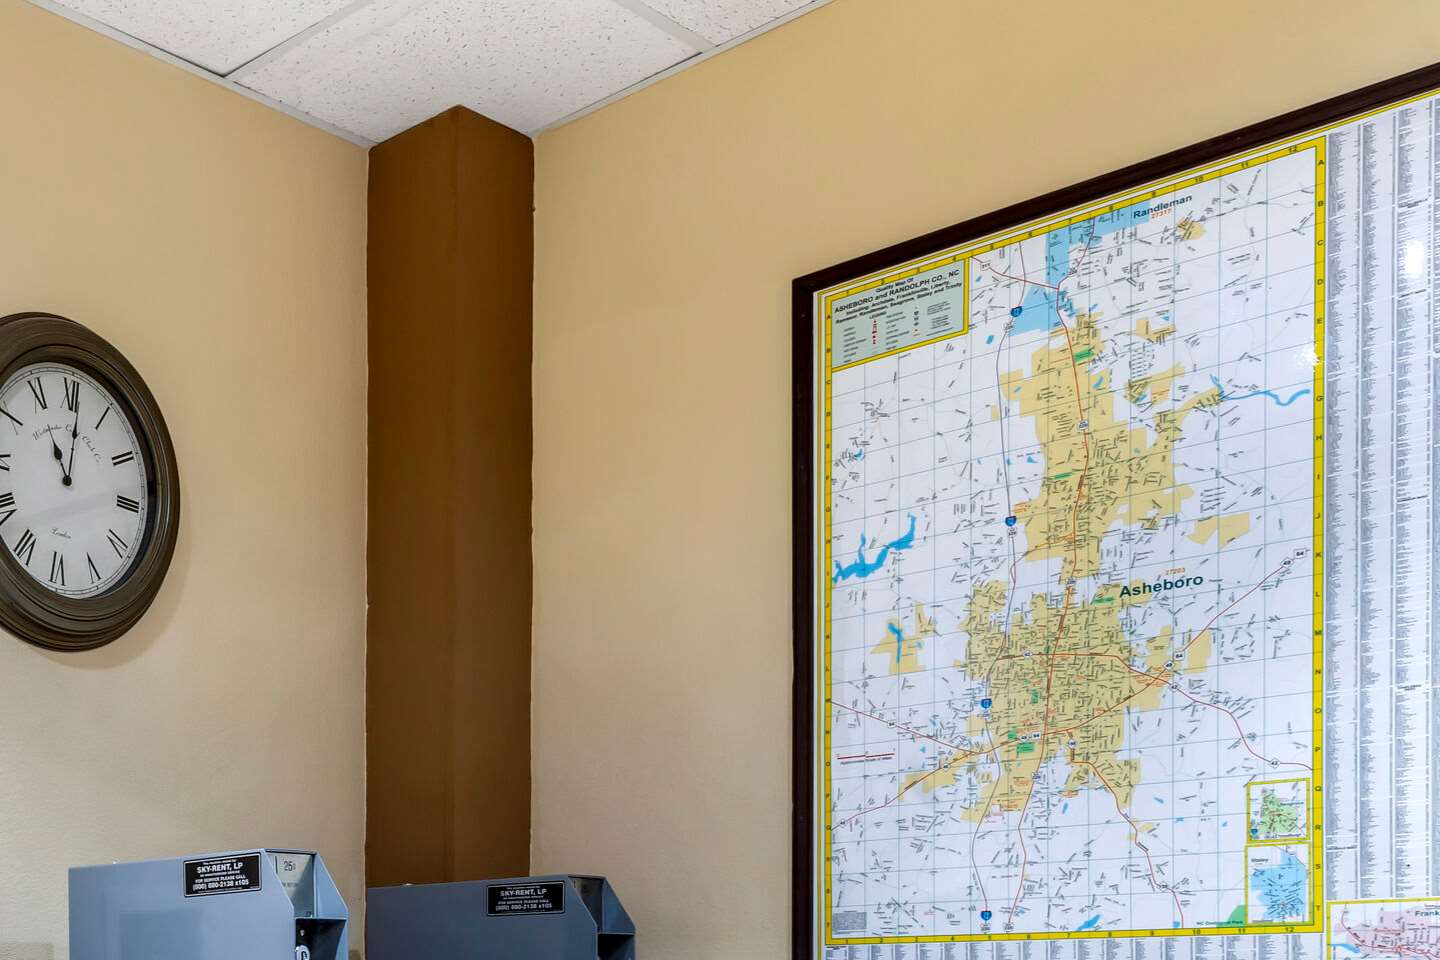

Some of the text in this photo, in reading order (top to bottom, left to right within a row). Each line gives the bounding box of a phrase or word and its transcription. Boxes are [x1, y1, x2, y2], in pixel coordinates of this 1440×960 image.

[1133, 194, 1193, 220] Randleman
[835, 296, 873, 313] ASHEBORO
[874, 292, 888, 301] and
[889, 279, 930, 297] RANDOLPH
[948, 269, 960, 278] NC
[1119, 575, 1204, 598] Asheboro
[197, 863, 232, 874] SKY-RENT,
[233, 862, 243, 870] LP
[500, 889, 536, 897] SKY-RENT,
